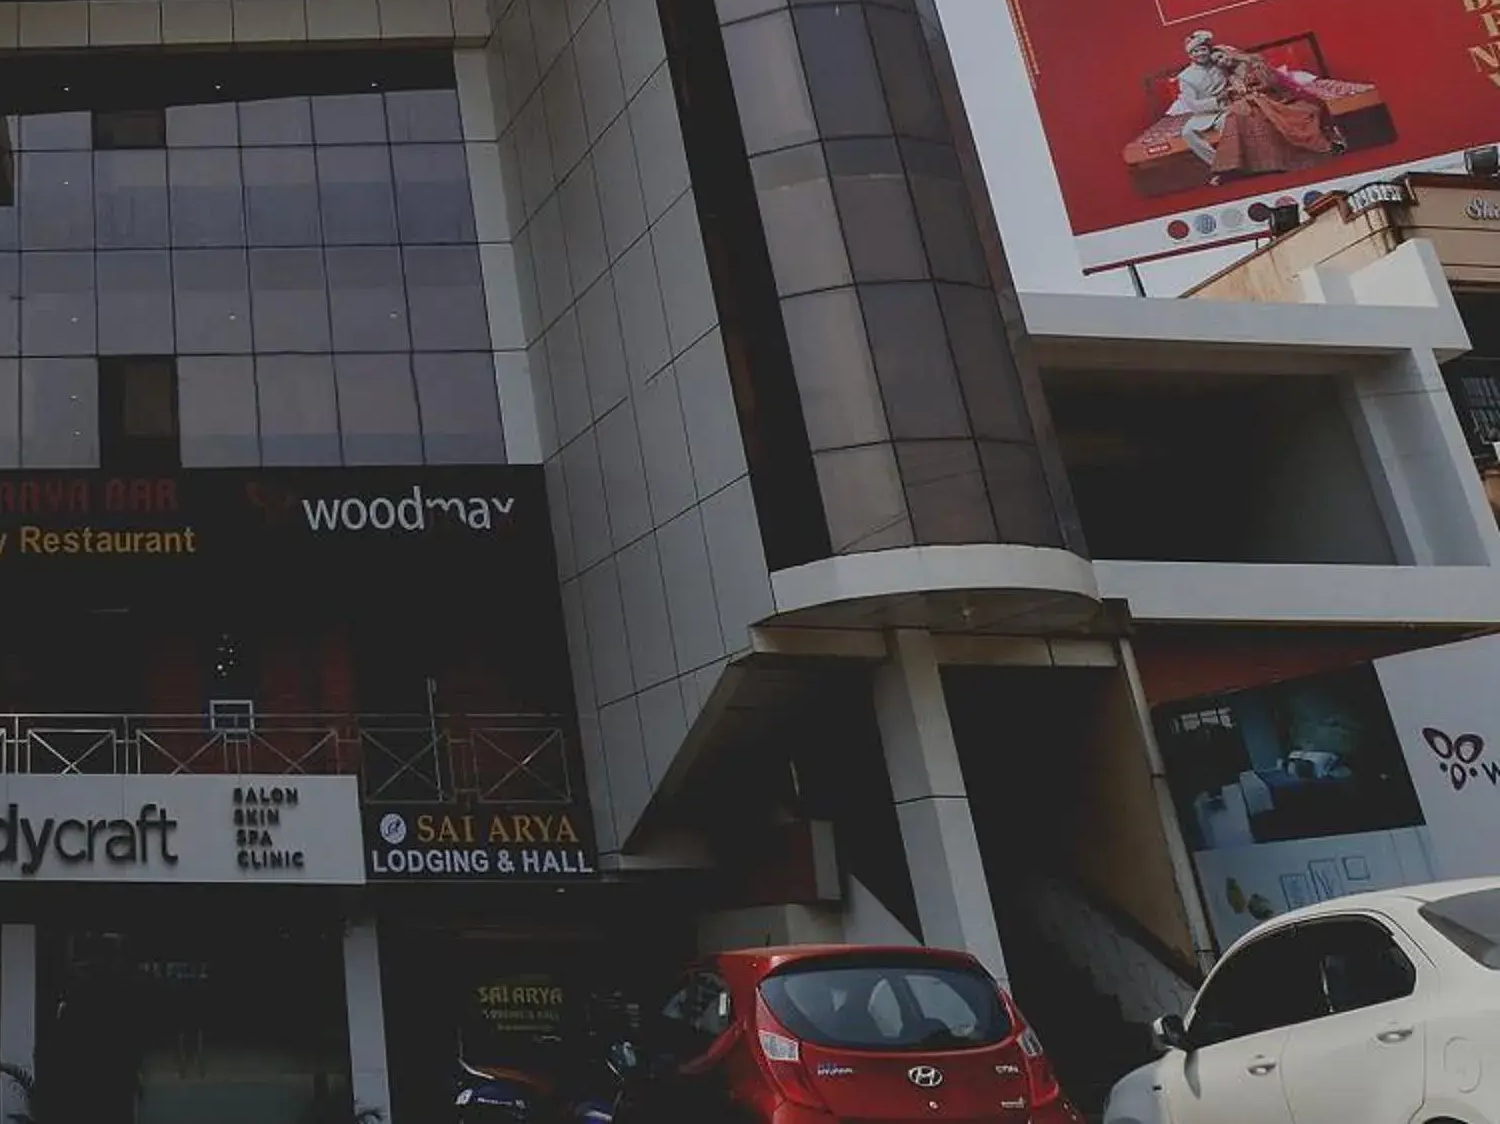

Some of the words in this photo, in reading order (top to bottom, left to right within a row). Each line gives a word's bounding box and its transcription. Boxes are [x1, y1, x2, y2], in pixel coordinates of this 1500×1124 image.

[105, 477, 180, 512] BAR
[18, 526, 198, 555] Restaurant
[233, 787, 299, 805] SALON
[233, 808, 280, 826] SKIN
[236, 829, 273, 847] SPA
[416, 814, 475, 843] SAI
[488, 814, 580, 843] ARYA
[237, 850, 304, 870] CLINIC
[372, 849, 490, 874] LODGING
[497, 849, 516, 874] &
[523, 849, 594, 874] HALL
[511, 984, 564, 1006] ARYA
